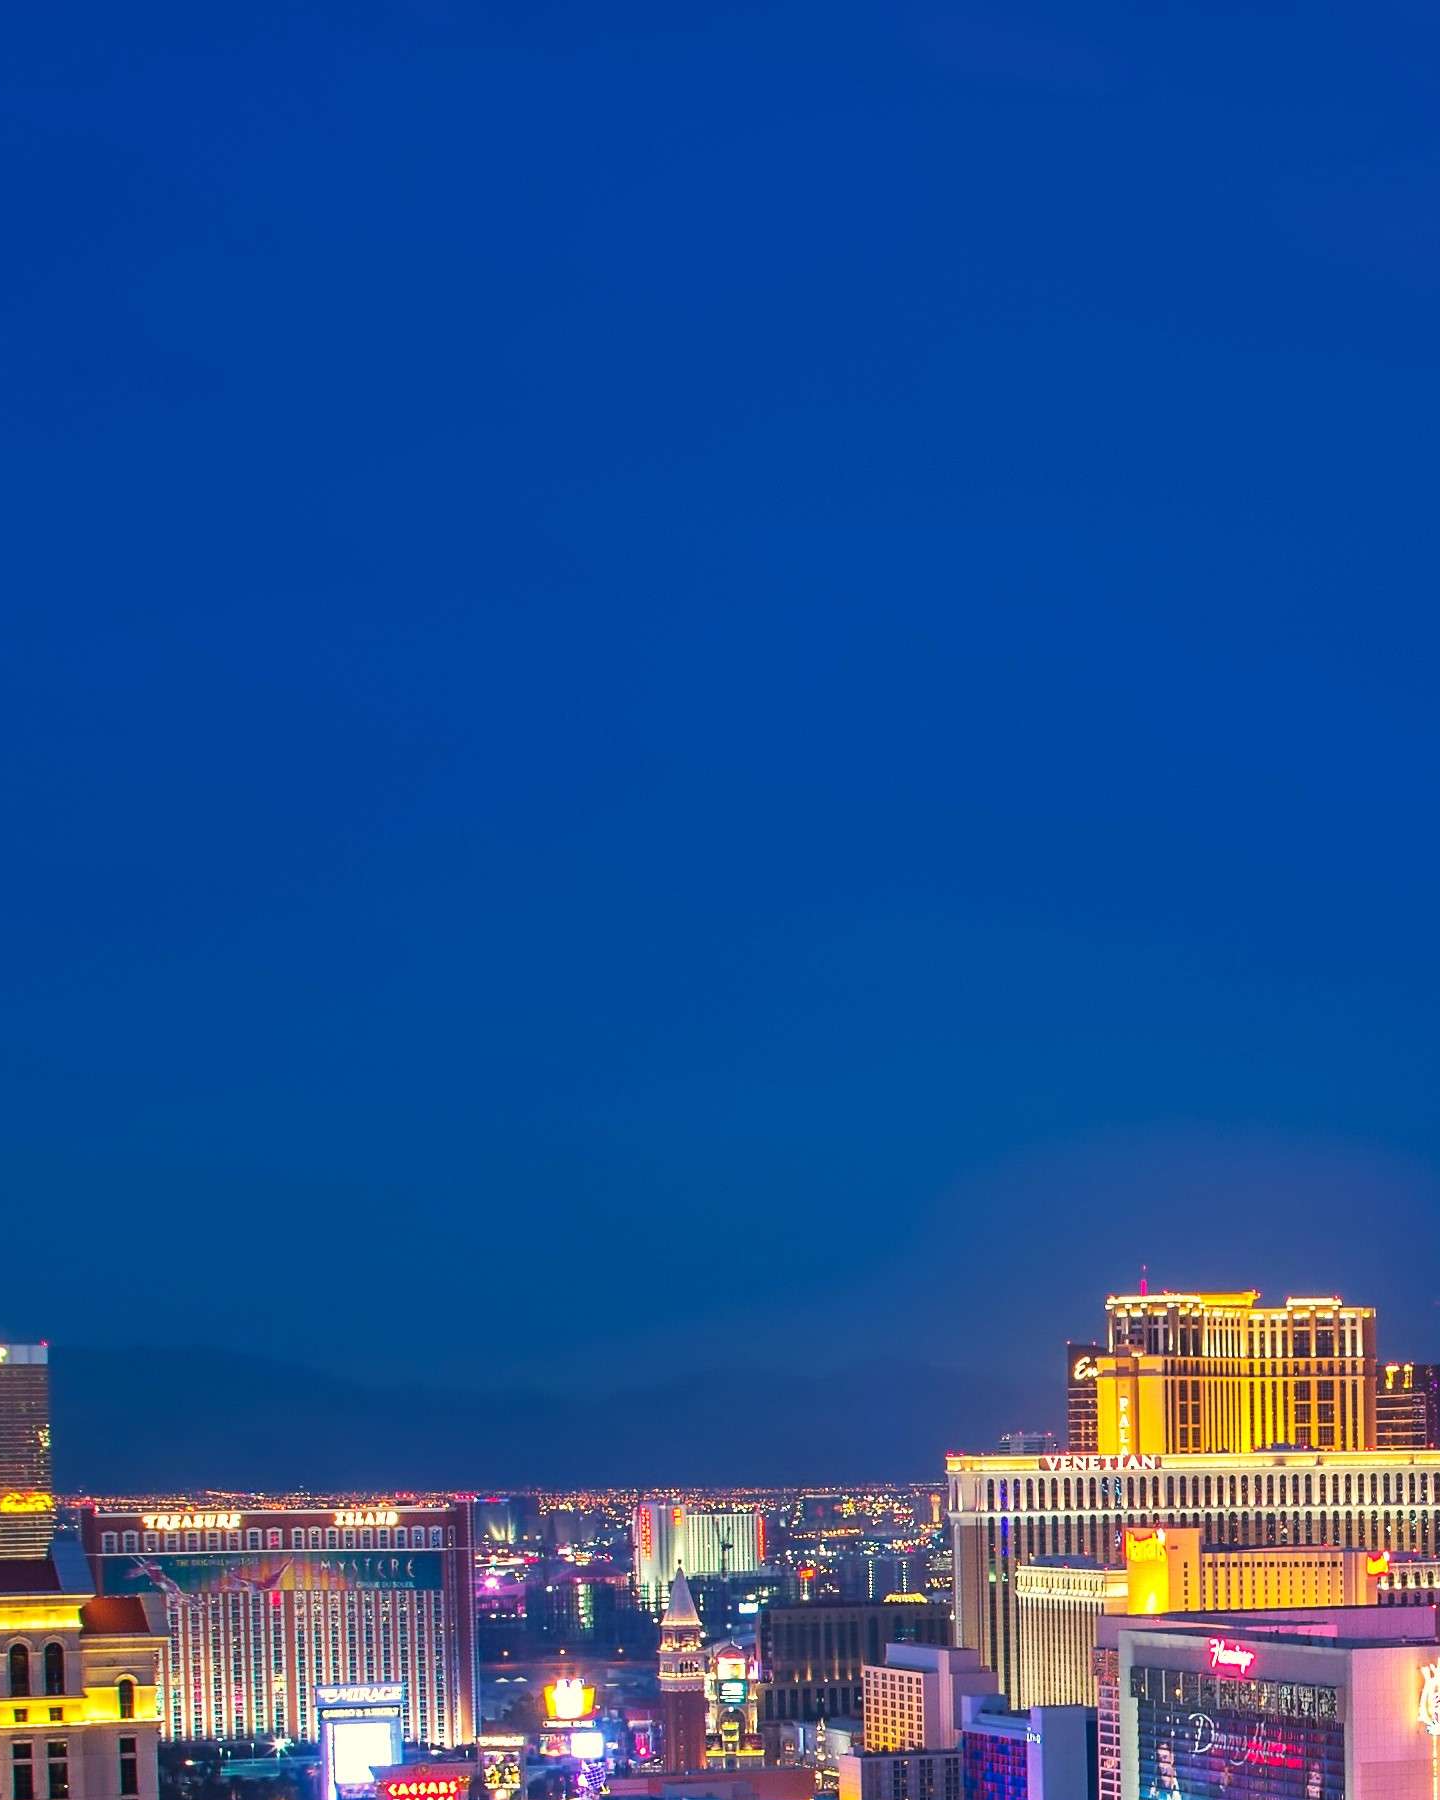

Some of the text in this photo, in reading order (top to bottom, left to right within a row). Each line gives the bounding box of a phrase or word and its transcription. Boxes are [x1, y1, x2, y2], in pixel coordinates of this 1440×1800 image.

[1043, 1455, 1156, 1470] VENETIAN
[143, 1511, 398, 1530] TREASURE ISLAND
[388, 1780, 457, 1797] CAESARS
